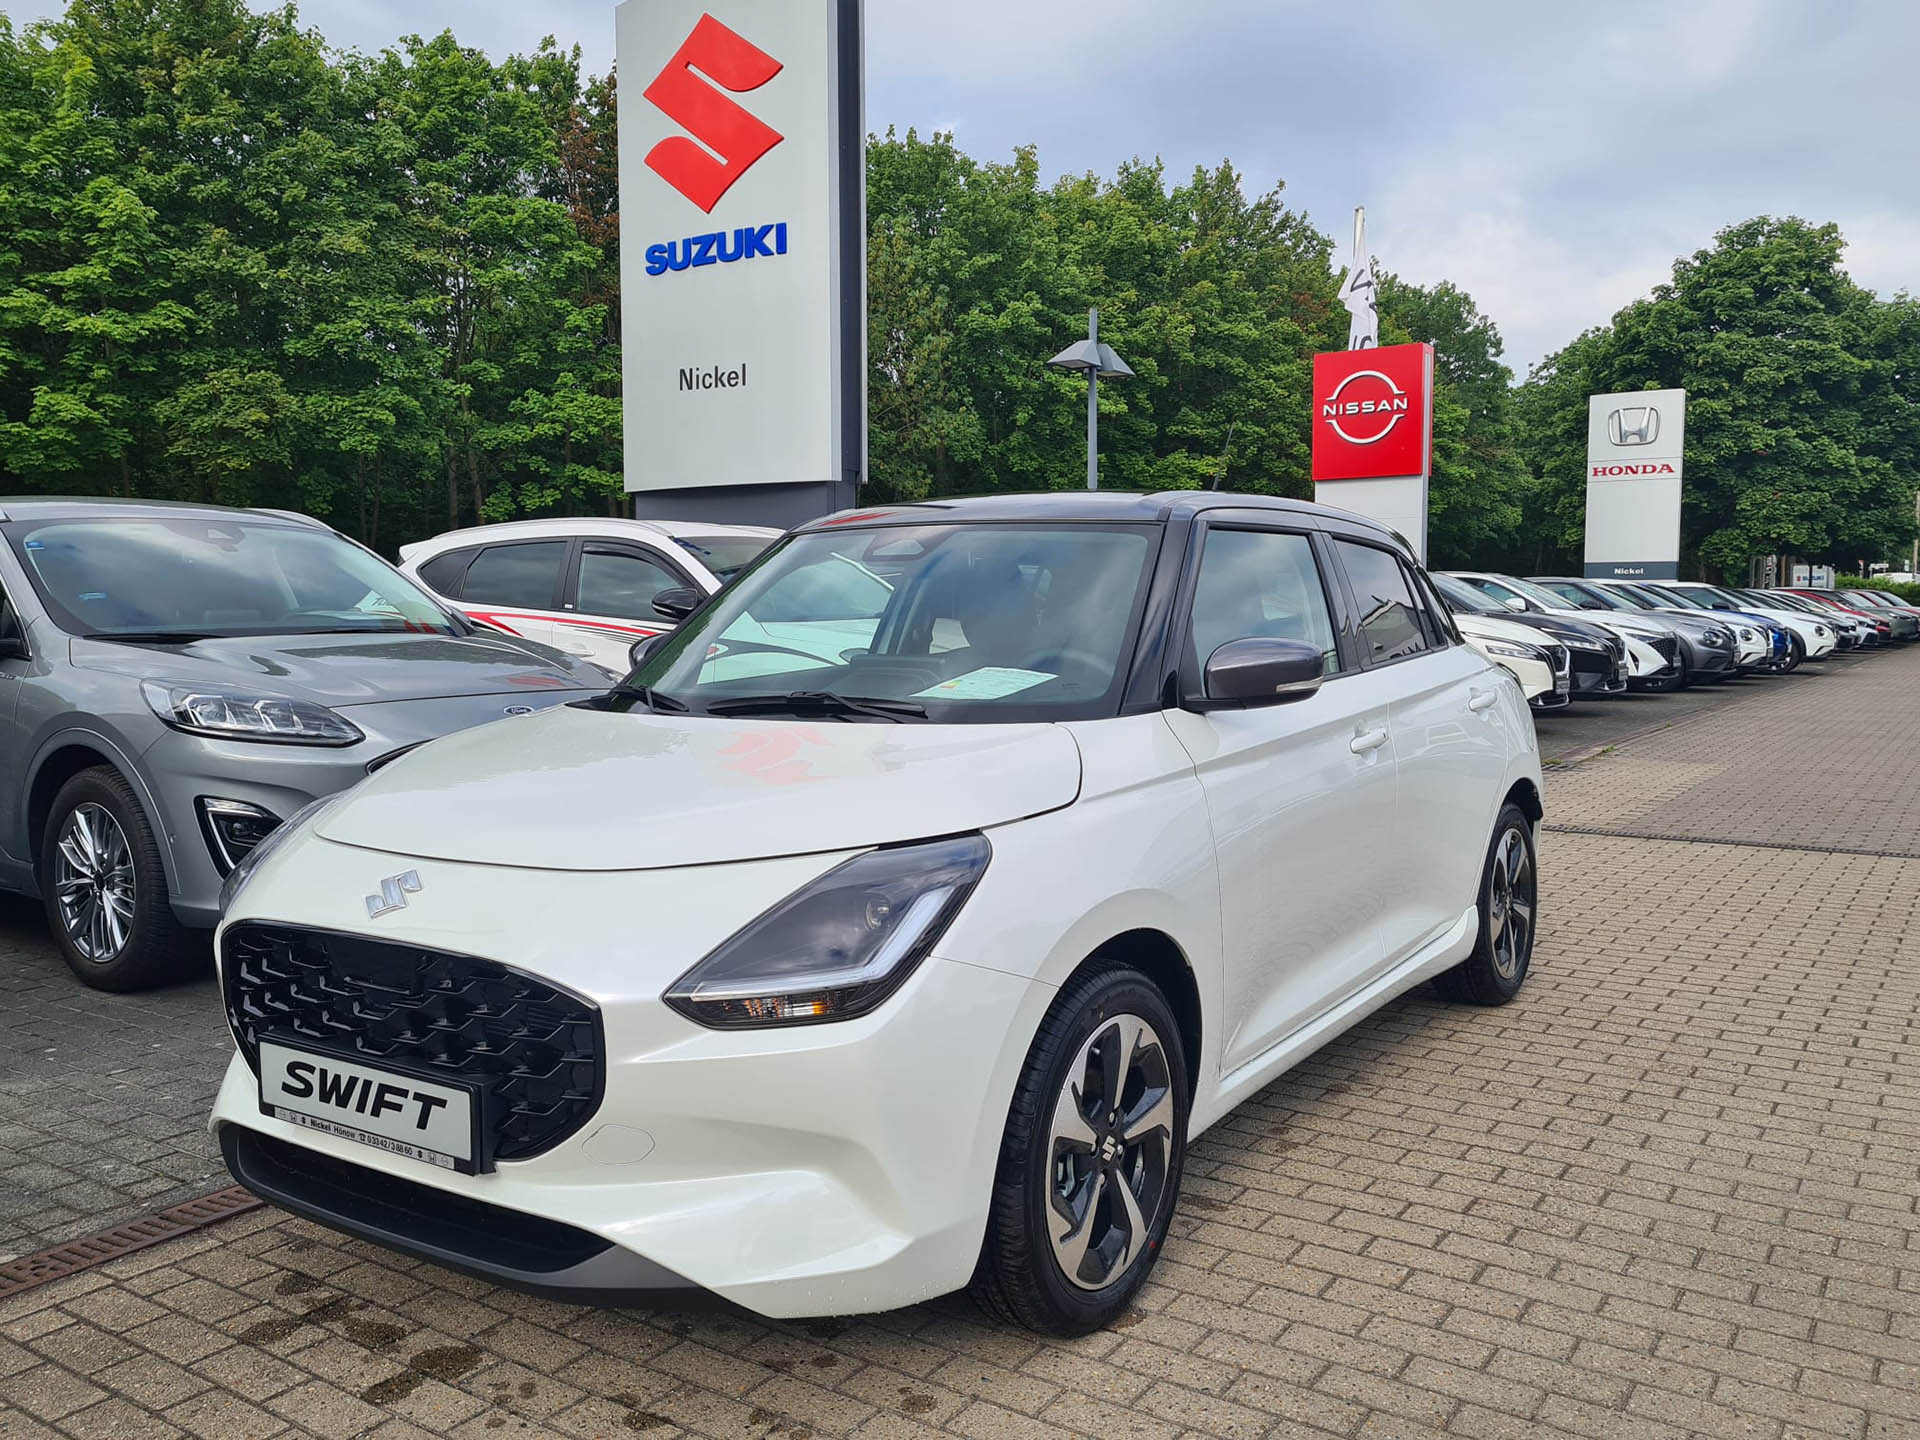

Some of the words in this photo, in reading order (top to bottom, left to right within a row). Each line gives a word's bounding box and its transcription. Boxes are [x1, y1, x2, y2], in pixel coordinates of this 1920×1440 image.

[644, 221, 788, 276] SUZUKI
[679, 363, 747, 391] Nickel
[1323, 397, 1408, 417] NISSAN
[1592, 463, 1675, 477] HONDA
[1614, 567, 1644, 575] Nickel
[281, 1061, 448, 1130] SWIFT
[310, 1119, 332, 1132] Nickel
